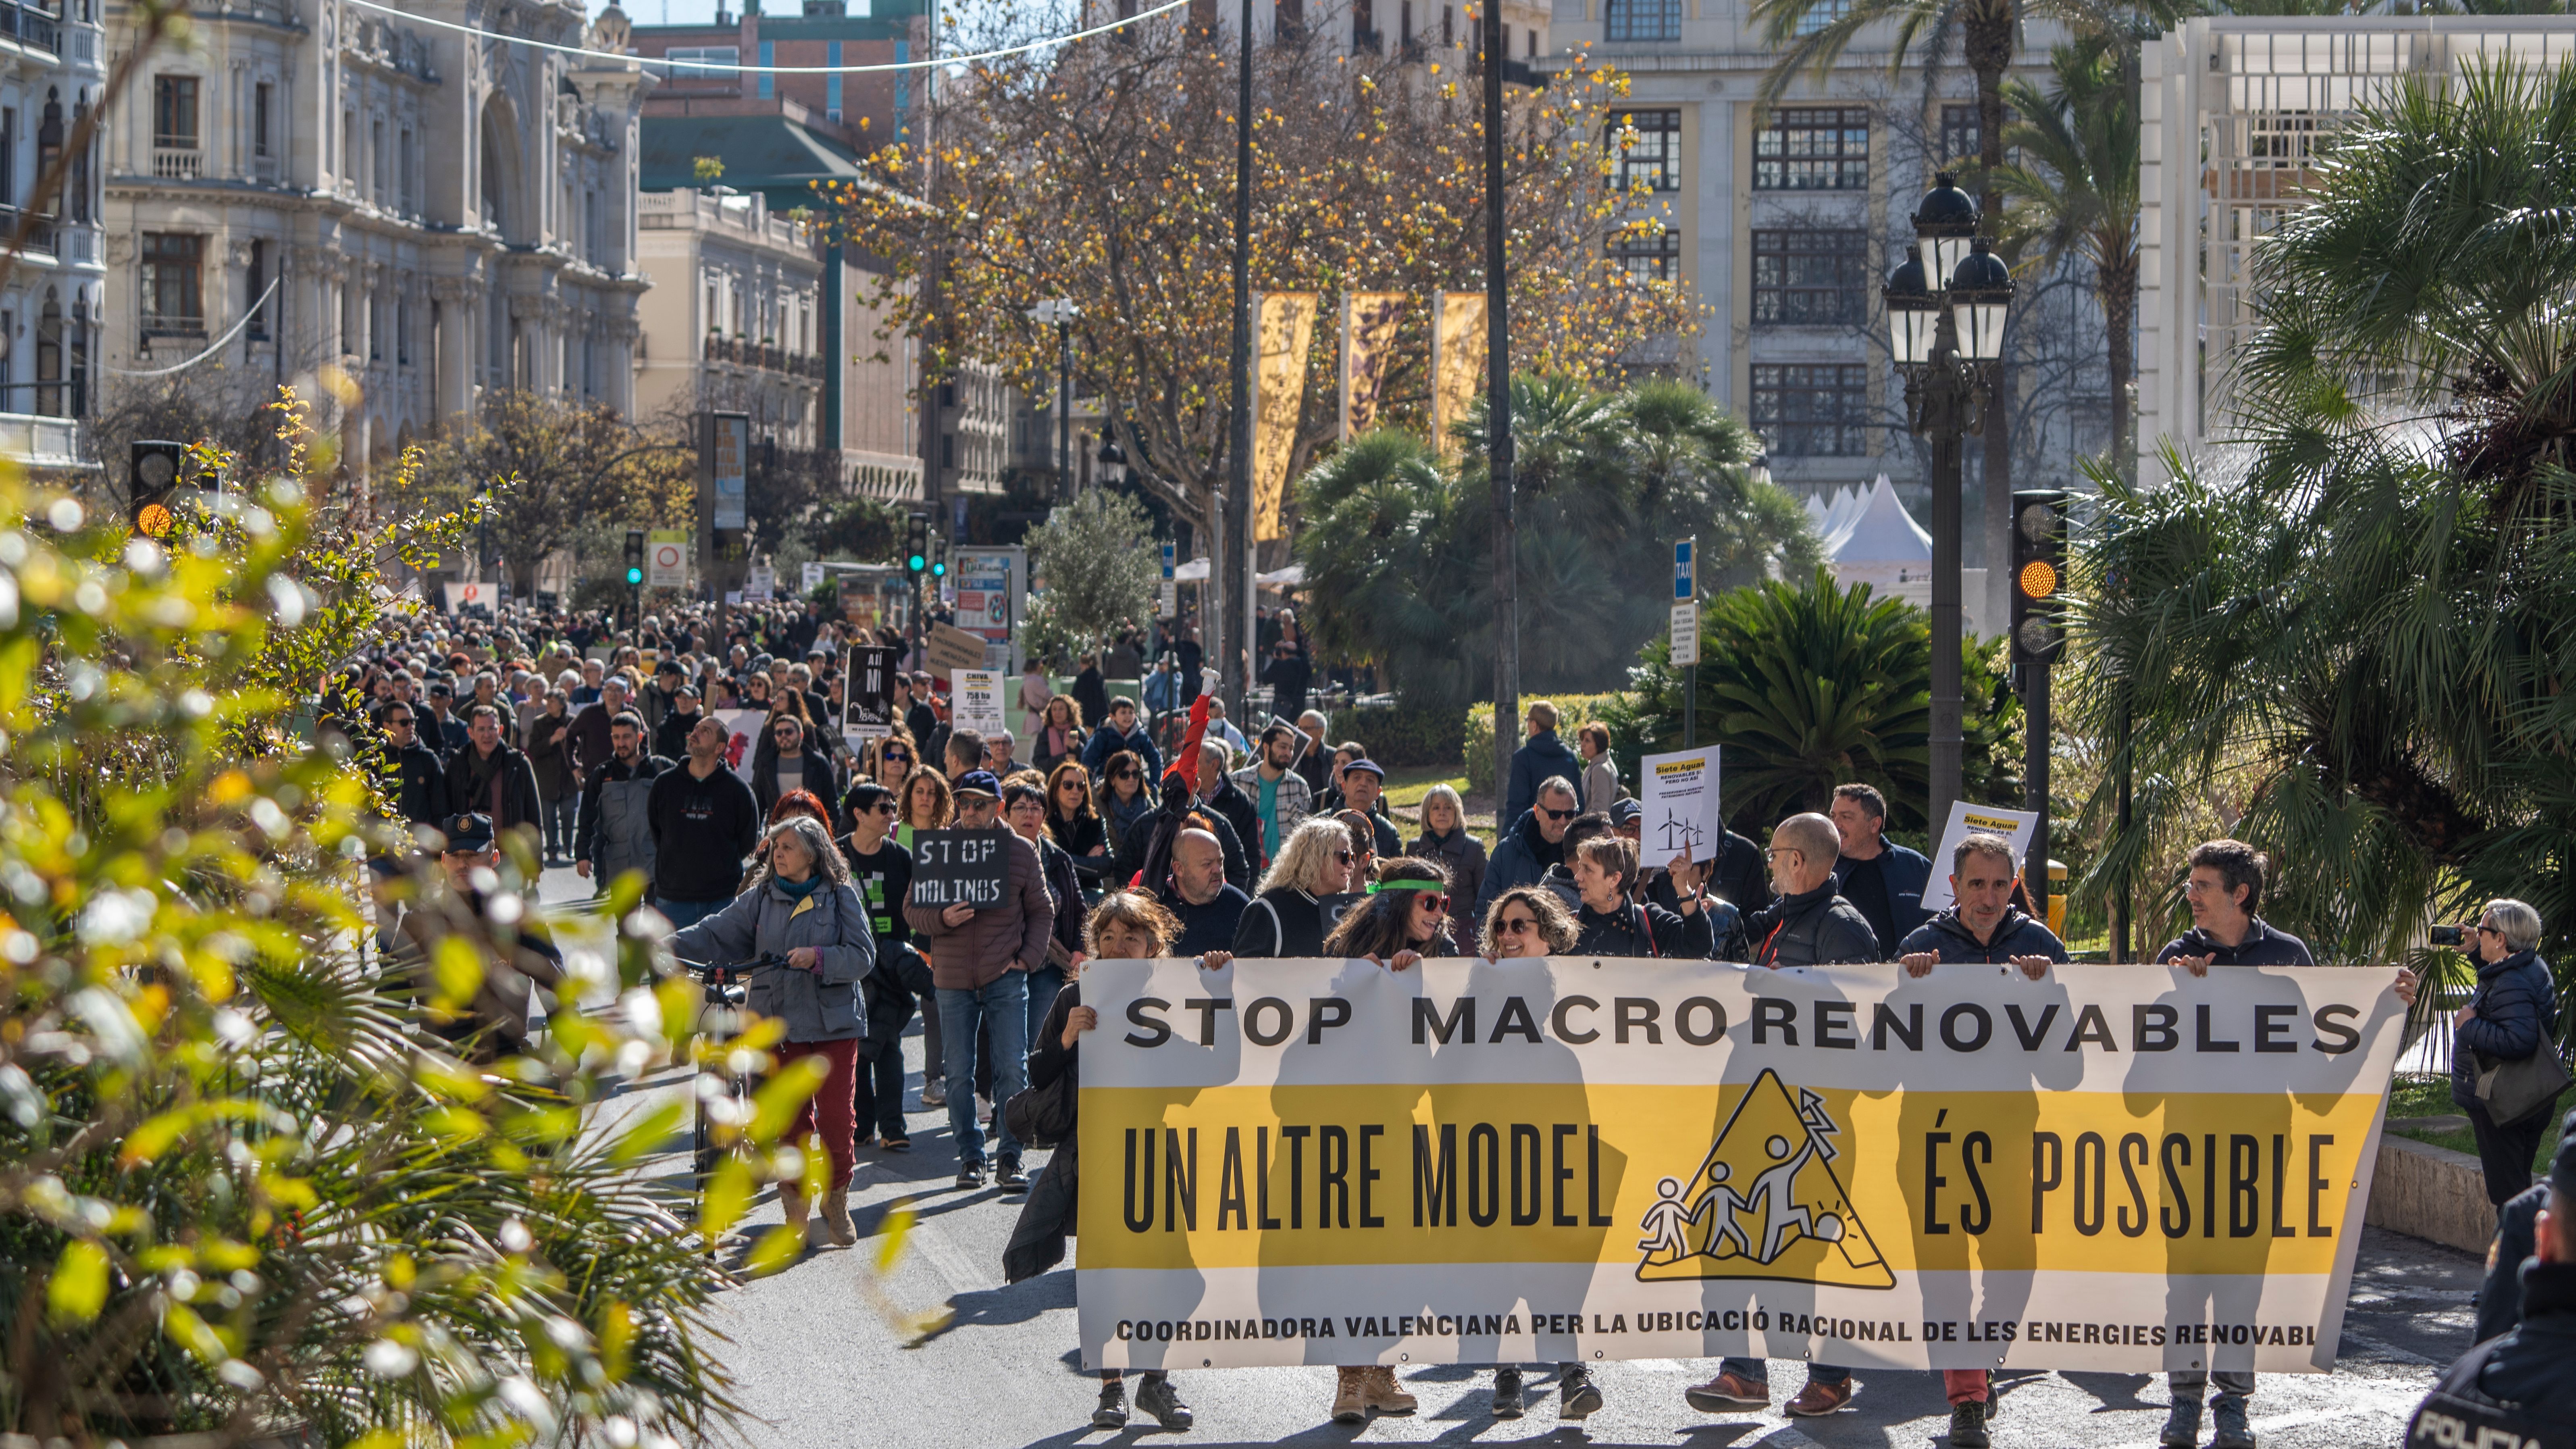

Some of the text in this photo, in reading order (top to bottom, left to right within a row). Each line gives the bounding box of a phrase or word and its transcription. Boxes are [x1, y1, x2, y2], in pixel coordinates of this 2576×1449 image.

[1676, 561, 1692, 579] TAXI
[1660, 770, 1695, 780] RENOVABLES
[1680, 761, 1705, 771] Aguas
[1964, 816, 2017, 829] Siete Aguas
[1967, 825, 2004, 835] RENOVABLES
[920, 839, 995, 864] STOP
[915, 879, 1000, 903] MOLINOS
[1124, 995, 2360, 1054] STOP MACRORENOVABLES
[1124, 1108, 2334, 1239] UN ALTRE MODEL ÉS POSSIBLE
[1116, 1317, 1336, 1342] COORDINADORA
[1344, 1314, 1521, 1338] VALENCIANA
[1532, 1314, 1584, 1334] PER
[1594, 1314, 1627, 1334] LA
[1638, 1306, 1769, 1332] UBICACIÓ
[1779, 1312, 1912, 1342] RACIONAL
[1922, 1322, 1957, 1341] DE
[1968, 1321, 2017, 1342] LES
[2028, 1321, 2166, 1346] ENERGIES
